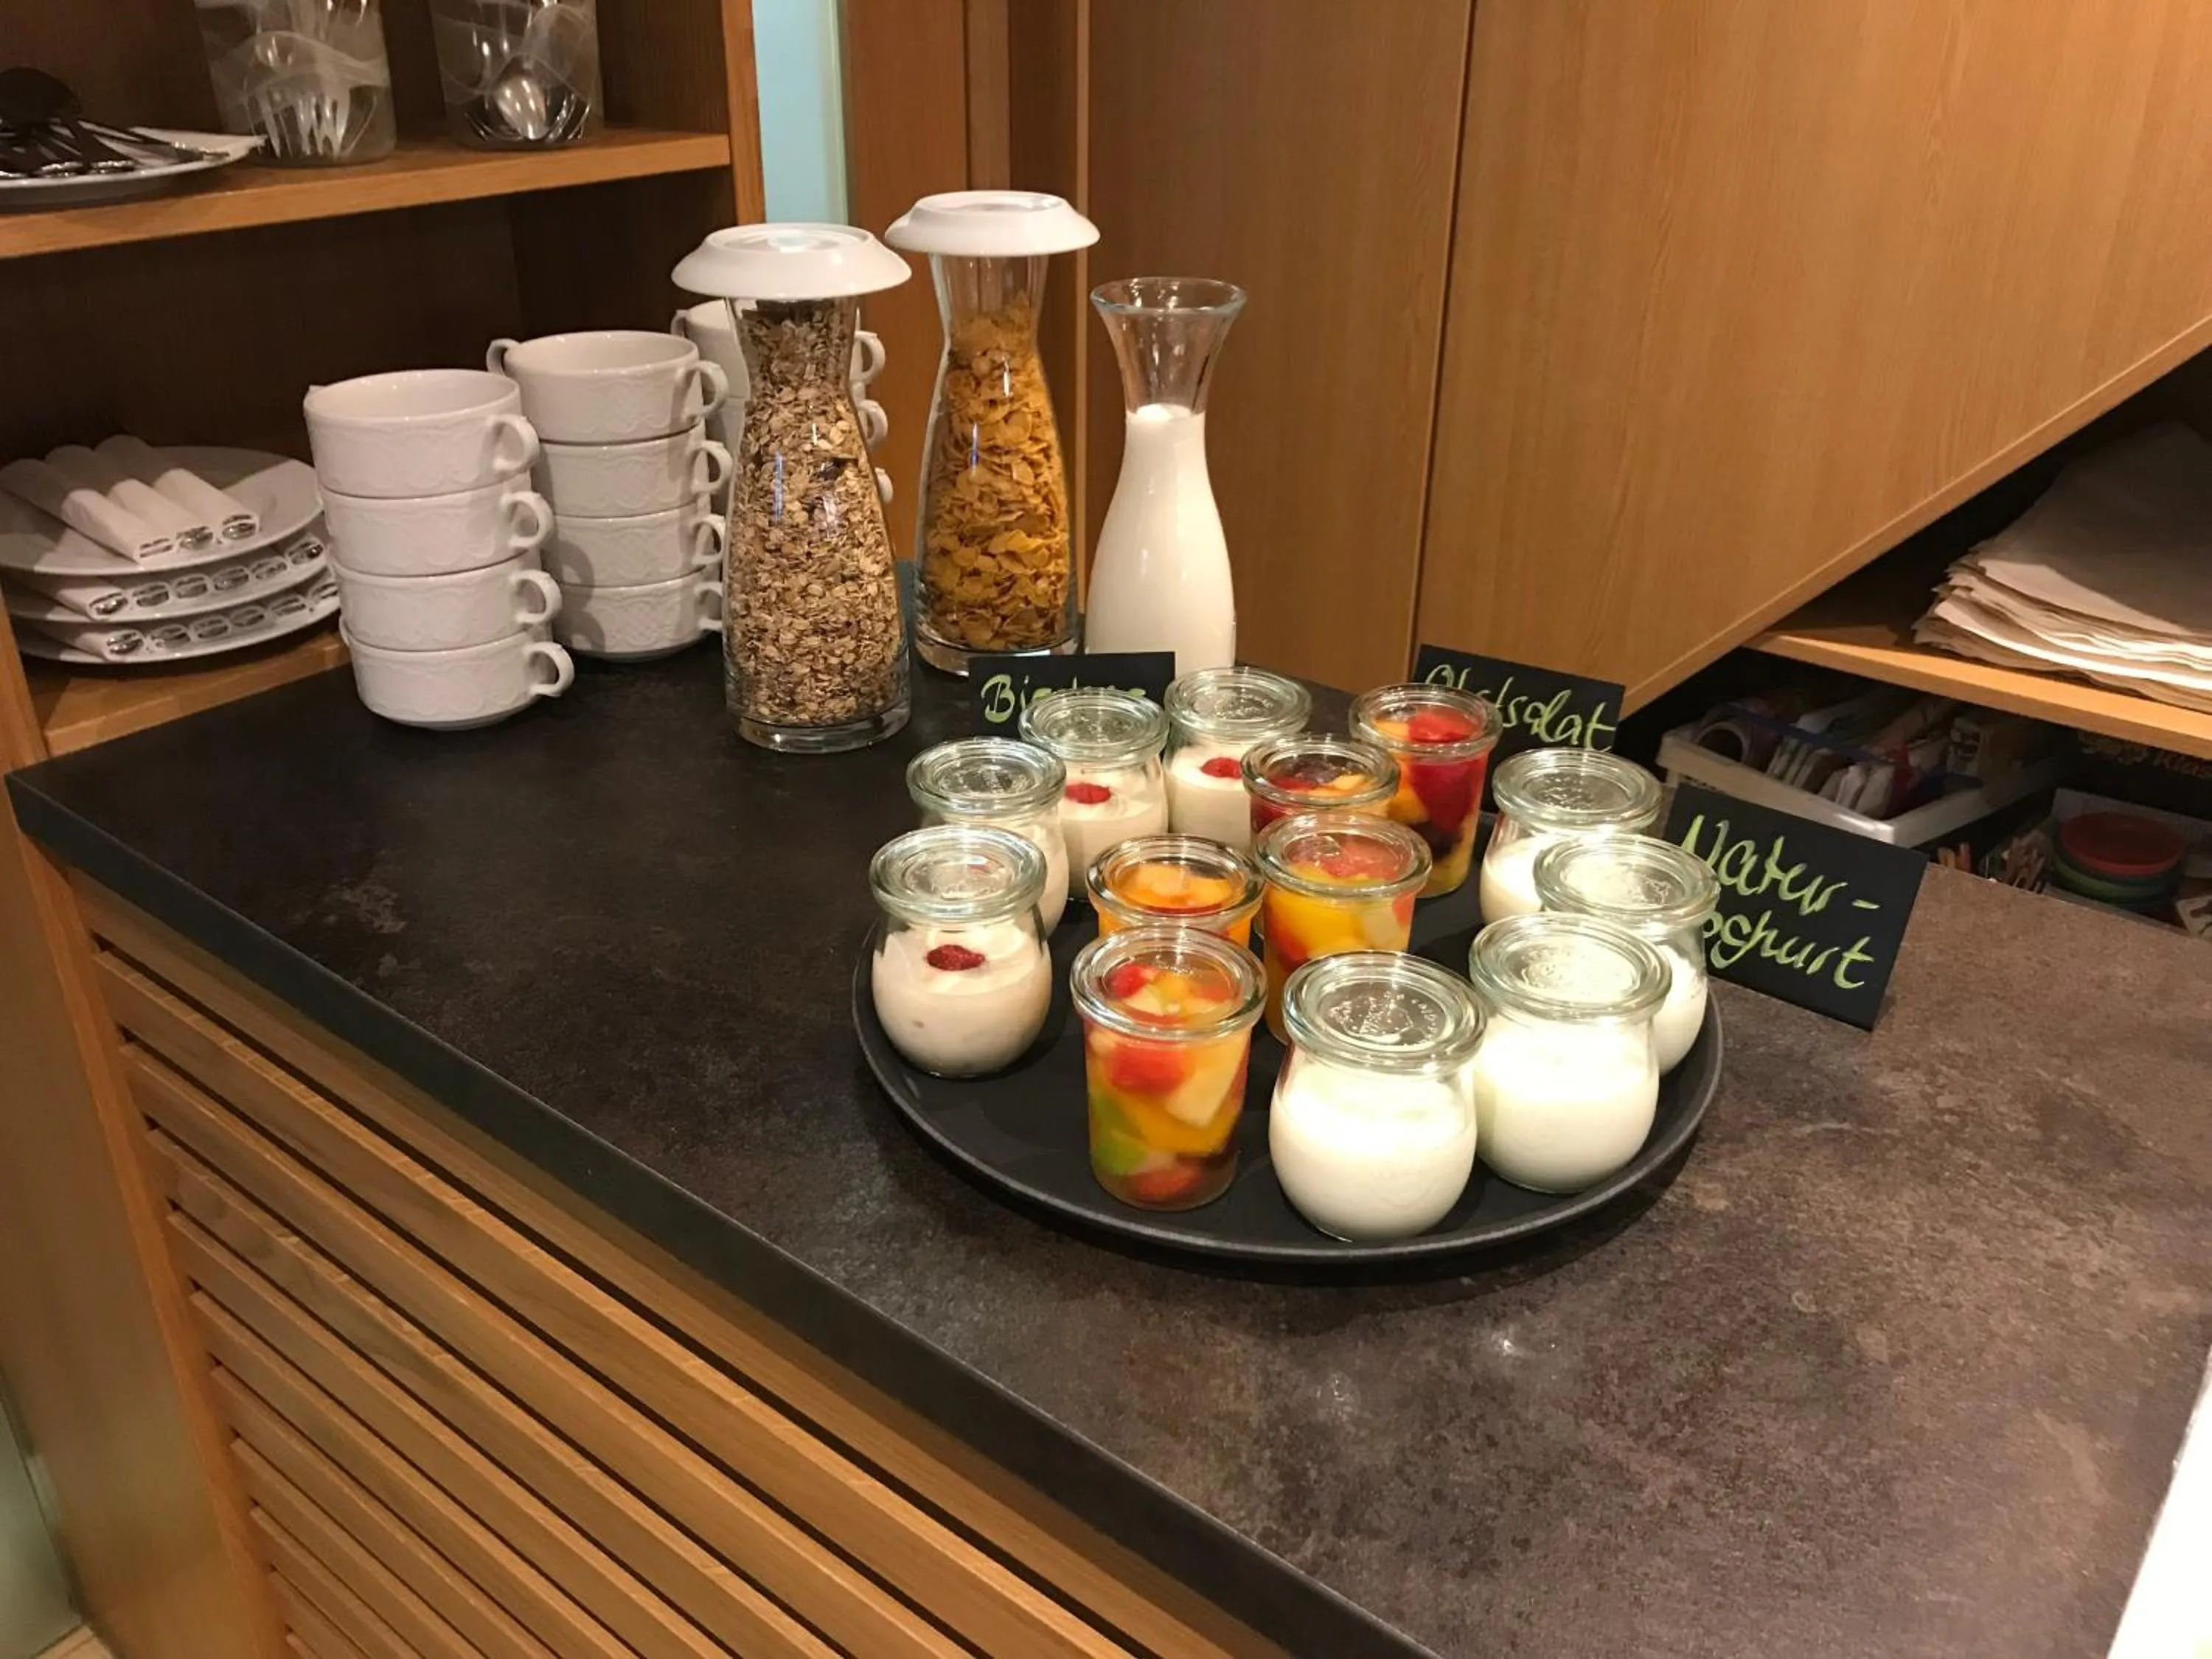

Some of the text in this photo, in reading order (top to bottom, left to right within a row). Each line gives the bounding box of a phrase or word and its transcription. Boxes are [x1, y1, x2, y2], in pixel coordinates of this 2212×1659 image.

[1425, 664, 1617, 753] tsalat
[1680, 814, 1880, 916] Natur-
[1702, 909, 1875, 990] oghurt
